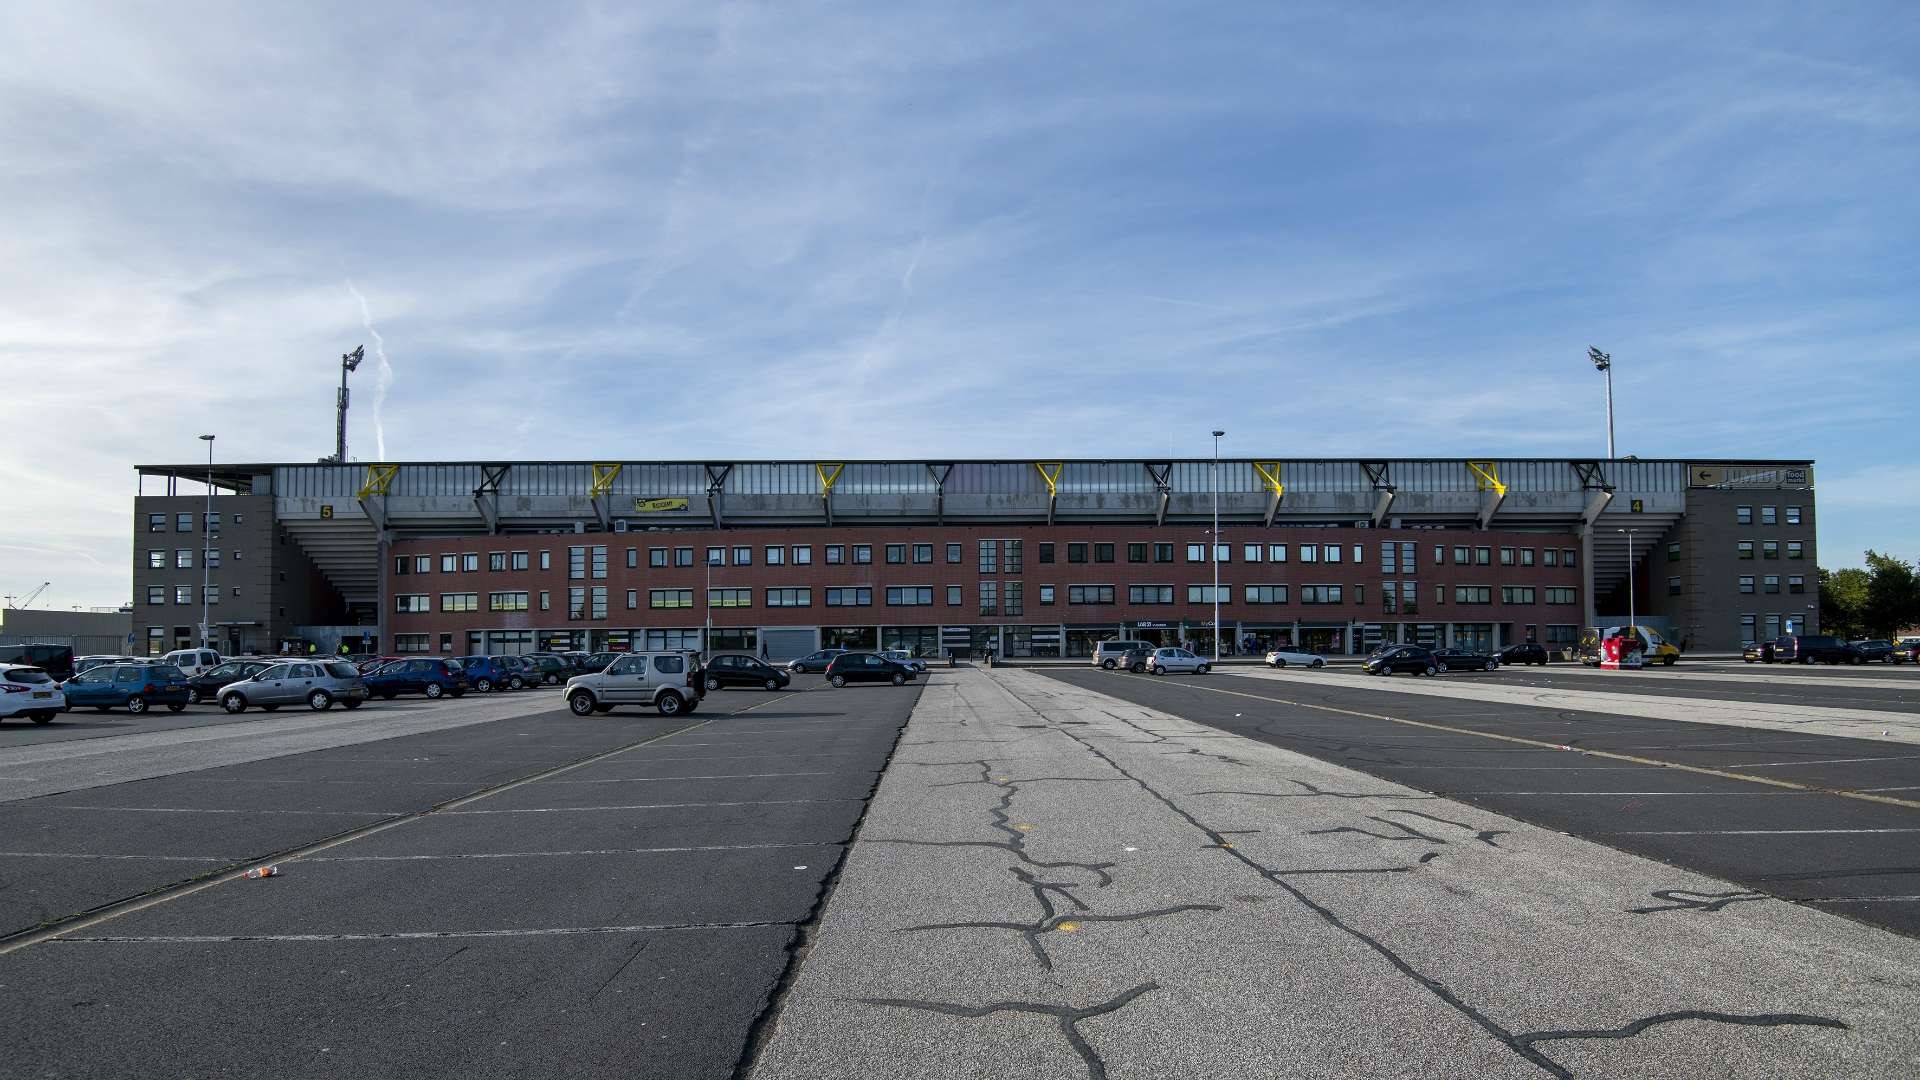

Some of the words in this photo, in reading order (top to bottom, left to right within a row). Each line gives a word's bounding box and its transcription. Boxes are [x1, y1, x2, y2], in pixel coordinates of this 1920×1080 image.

[1786, 470, 1804, 478] food
[322, 506, 332, 518] 5
[1633, 501, 1641, 512] 4
